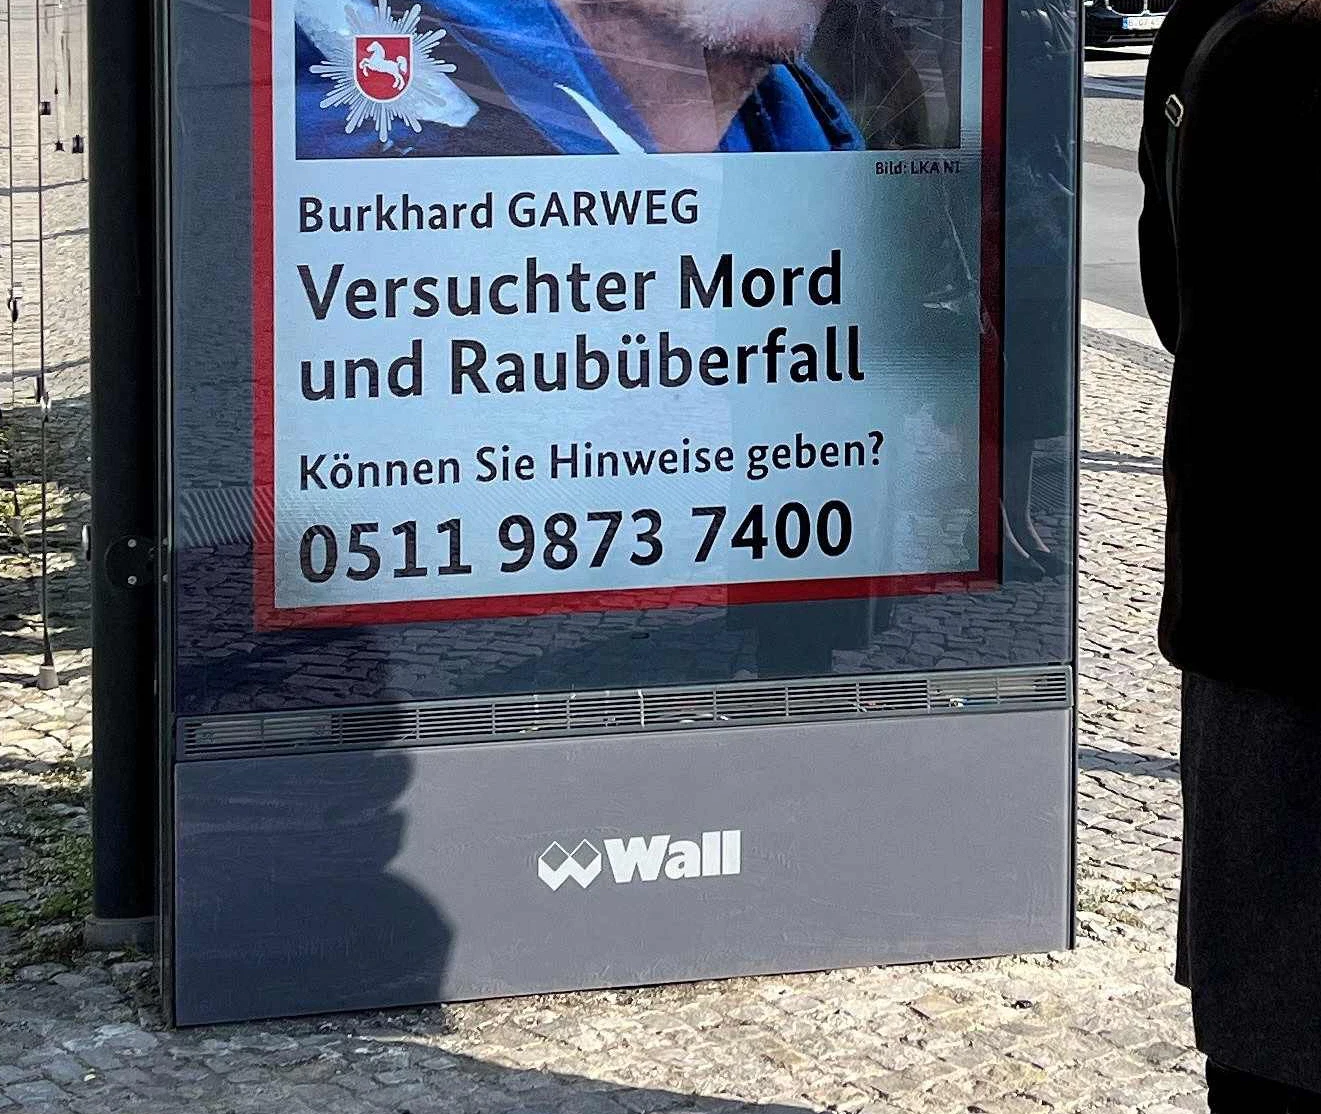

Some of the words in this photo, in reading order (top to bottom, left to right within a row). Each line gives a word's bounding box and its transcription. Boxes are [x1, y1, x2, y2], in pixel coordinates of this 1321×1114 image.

[874, 160, 908, 176] Bild:
[910, 160, 941, 175] LKA
[298, 191, 494, 234] Burkhard
[507, 188, 699, 229] GARWEG
[296, 256, 657, 321] Versuchter
[679, 248, 842, 310] Mord
[300, 338, 424, 402] und
[450, 324, 866, 396] Raubüberfall
[299, 452, 461, 491] Können
[475, 444, 536, 483] Sie
[549, 437, 735, 480] Hinweise
[745, 429, 885, 481] geben?
[298, 518, 473, 584] 0511
[497, 508, 664, 574] 9873
[690, 499, 853, 563] 7400
[602, 828, 742, 885] Wall
